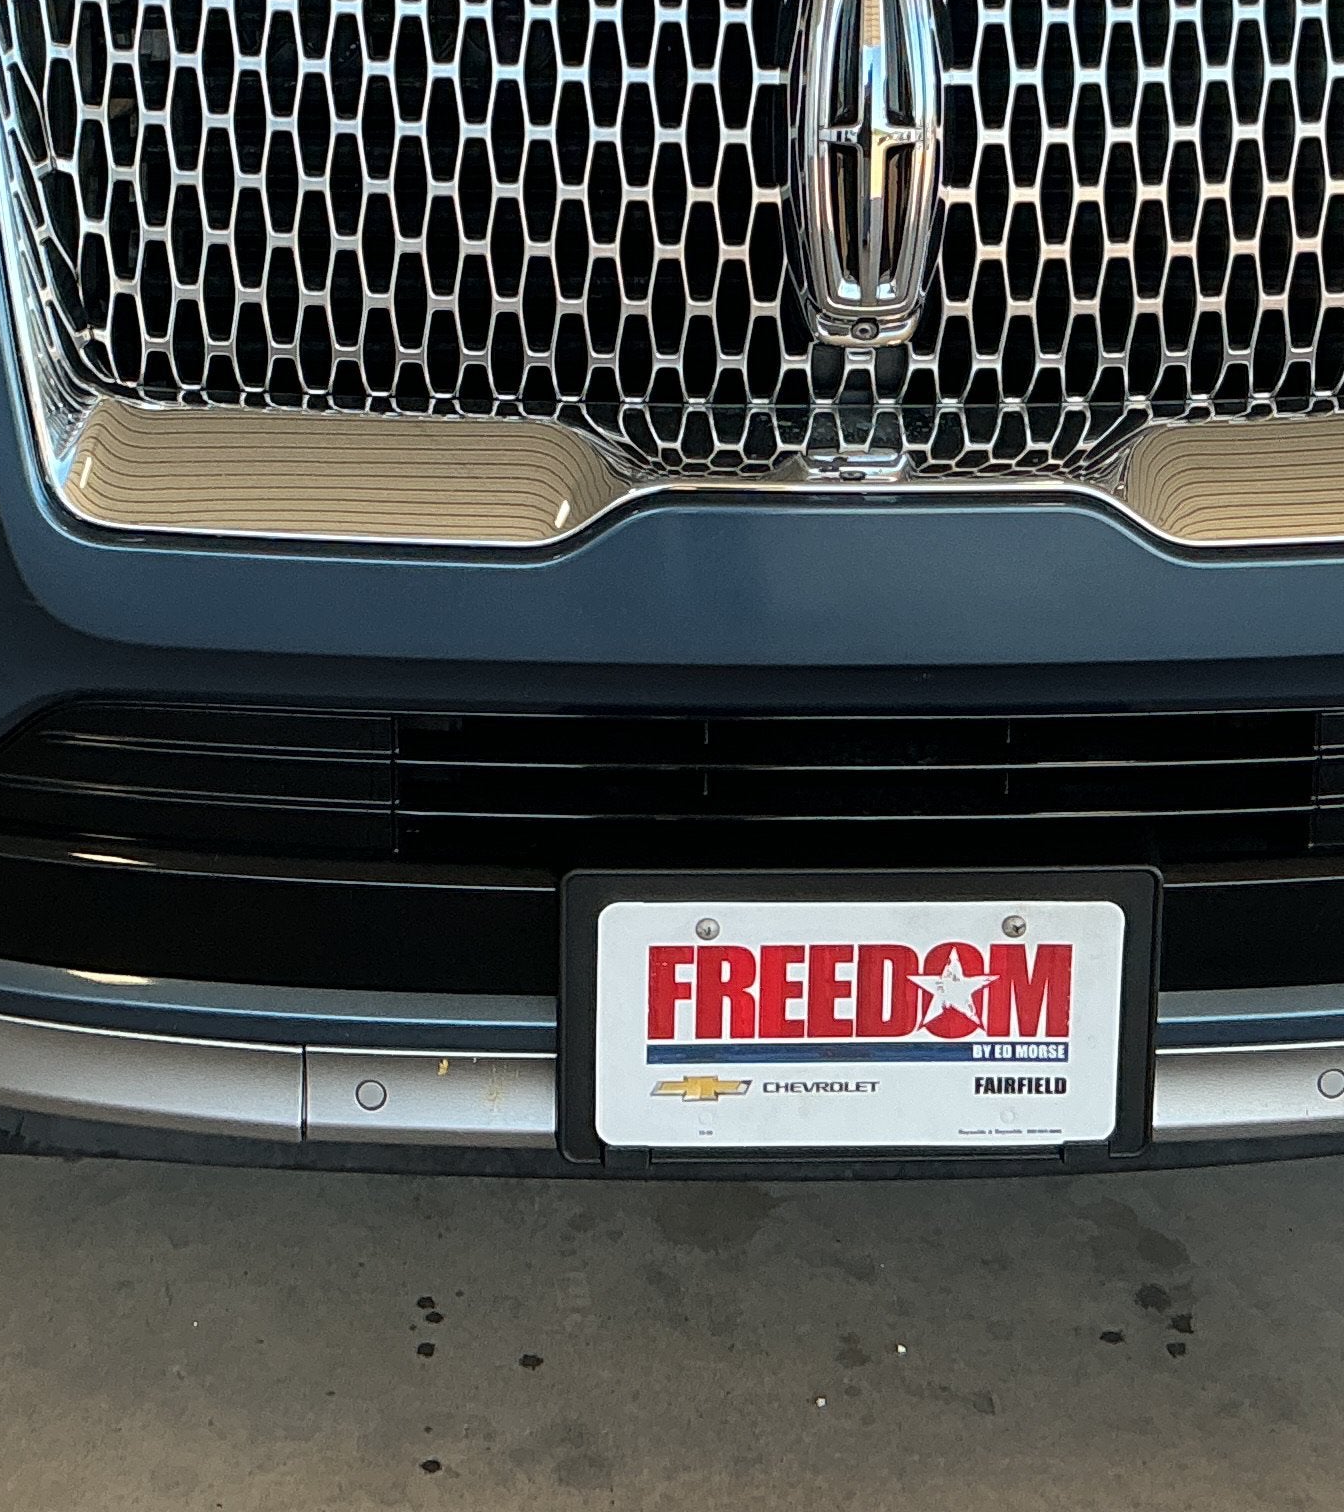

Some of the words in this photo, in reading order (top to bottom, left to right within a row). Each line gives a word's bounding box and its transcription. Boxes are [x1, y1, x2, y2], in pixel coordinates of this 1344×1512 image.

[647, 942, 1073, 1040] FREEDOM
[972, 1044, 992, 1058] BY
[994, 1044, 1012, 1058] ED
[1015, 1044, 1065, 1058] MORSE
[762, 1080, 880, 1094] CHEVROLET
[974, 1076, 1067, 1094] FAIRFIELD
